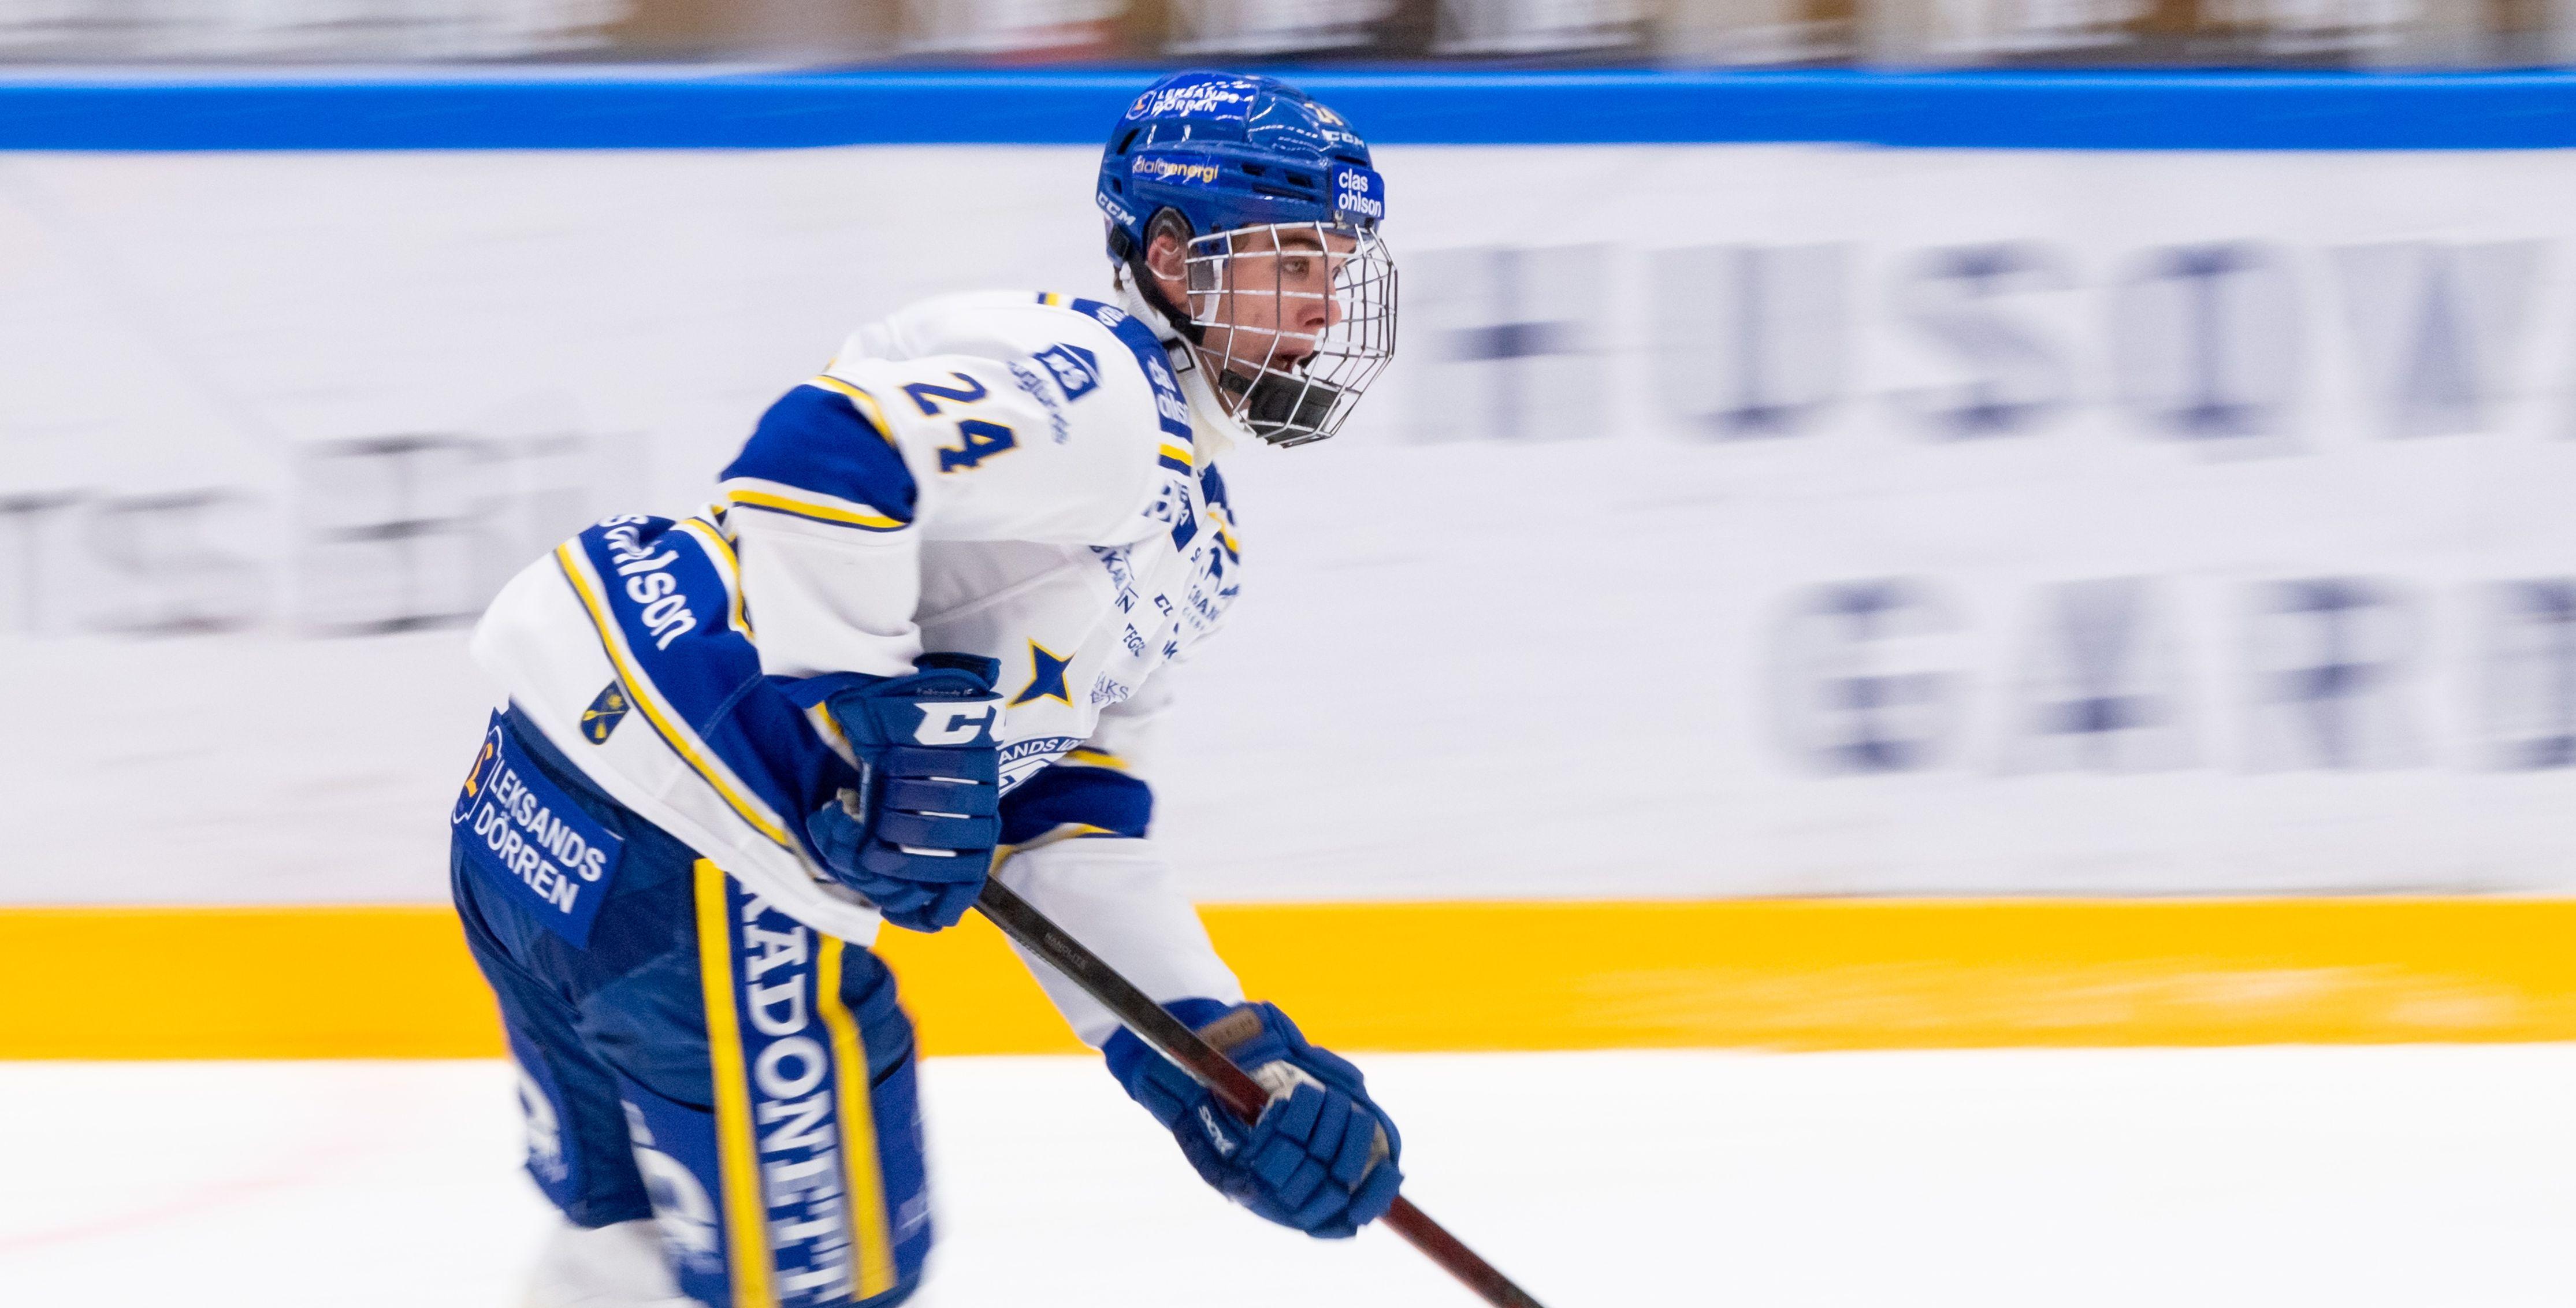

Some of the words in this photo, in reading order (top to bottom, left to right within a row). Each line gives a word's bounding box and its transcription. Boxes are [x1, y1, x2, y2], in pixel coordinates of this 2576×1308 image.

[1098, 191, 1136, 226] CCM
[1339, 168, 1369, 192] clas
[1339, 189, 1382, 218] ohlson
[898, 370, 1021, 475] 24
[489, 759, 607, 882] LEKSANDS
[474, 801, 580, 914] DÖRREN
